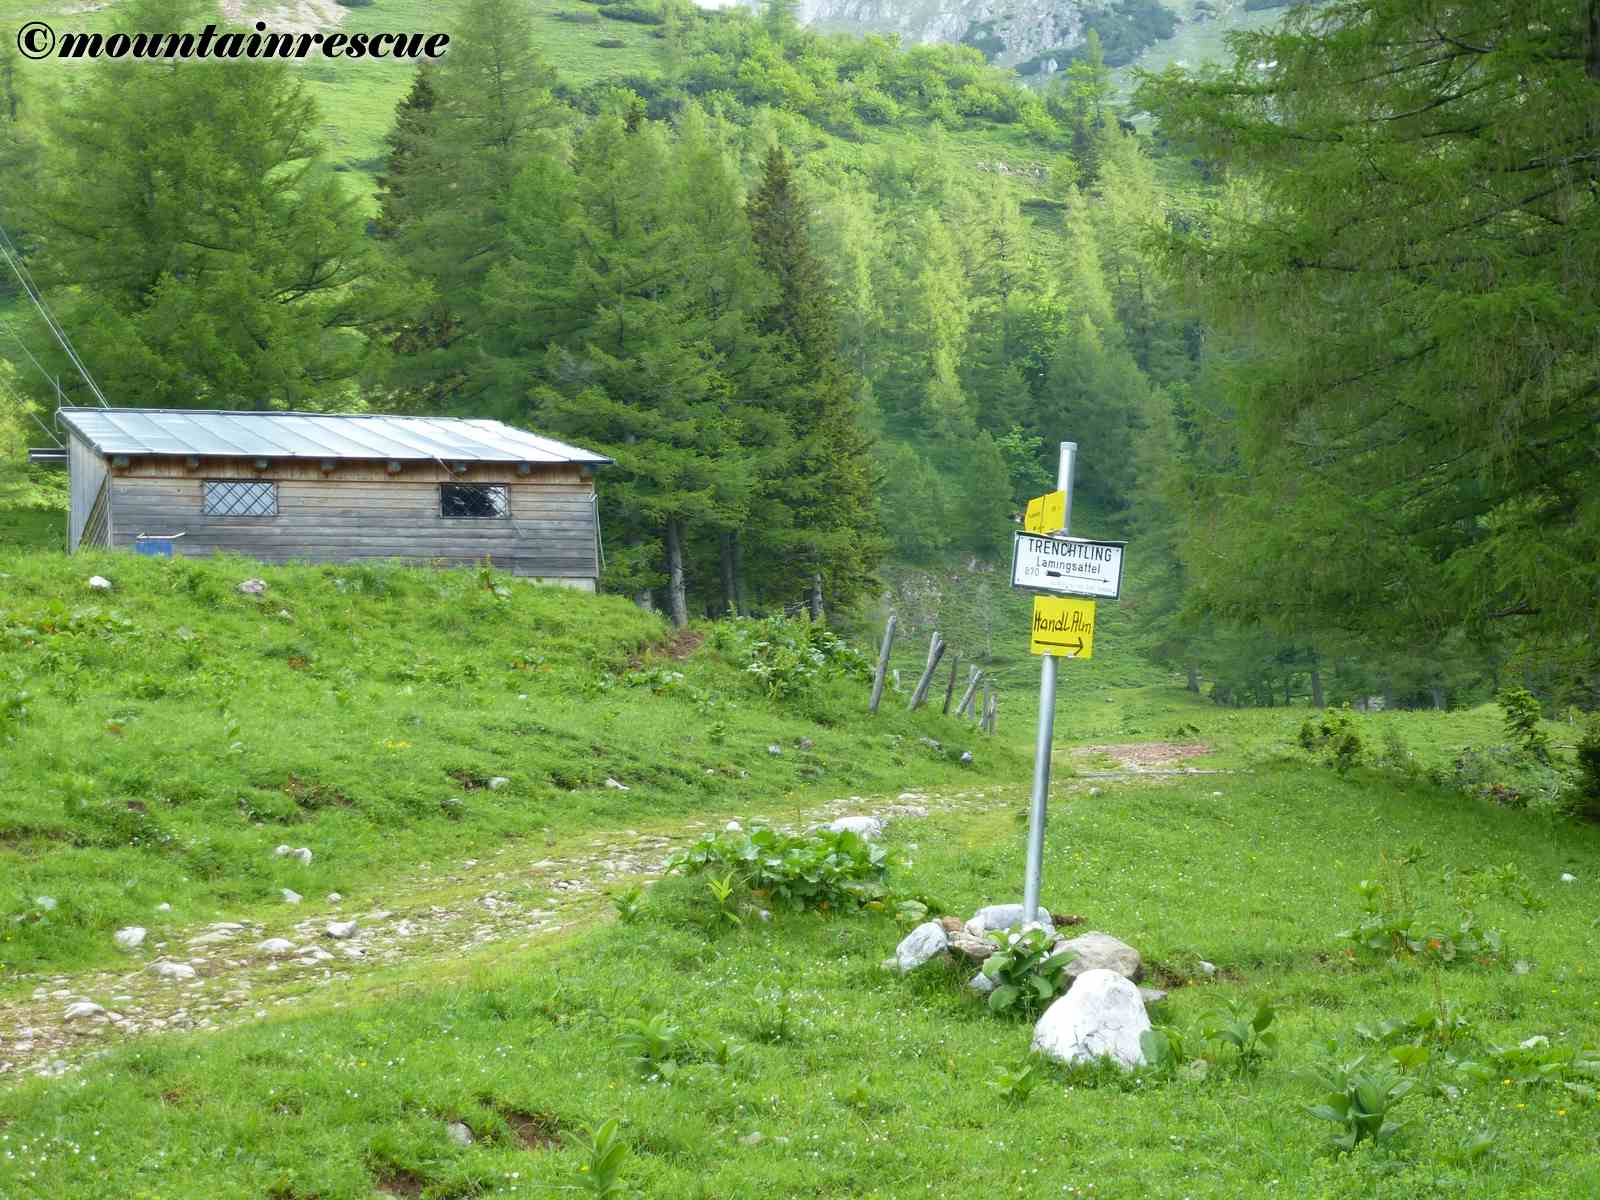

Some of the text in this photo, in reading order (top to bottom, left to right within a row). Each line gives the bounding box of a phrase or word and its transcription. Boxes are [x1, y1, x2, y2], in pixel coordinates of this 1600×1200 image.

[1029, 539, 1112, 562] TRENCHTLING
[1036, 556, 1101, 574] Lamingsattel
[1070, 611, 1092, 635] Alm
